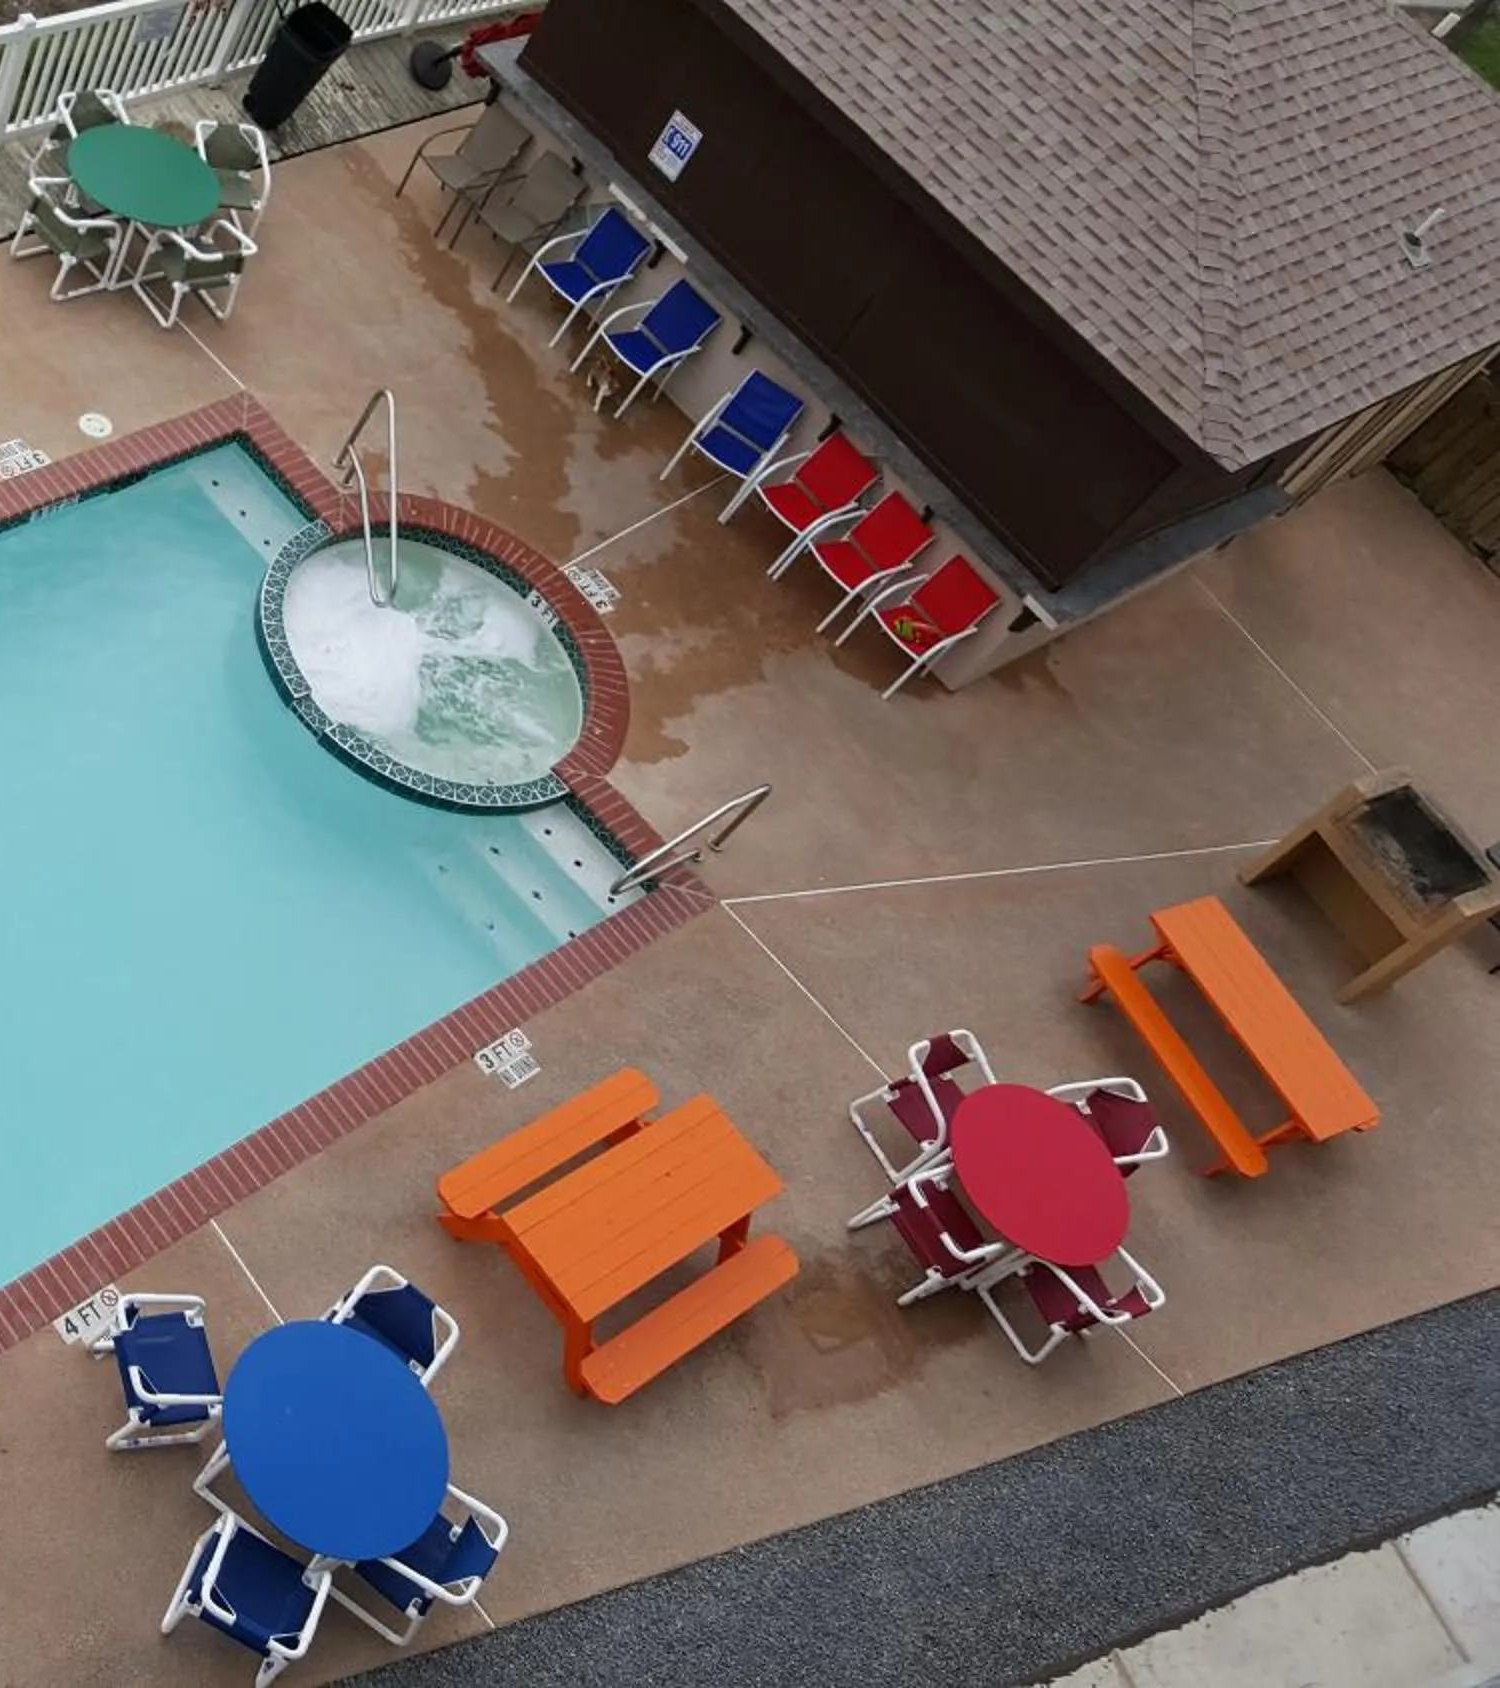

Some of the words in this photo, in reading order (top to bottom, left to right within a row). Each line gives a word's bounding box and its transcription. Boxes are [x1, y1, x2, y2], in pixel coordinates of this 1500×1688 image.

[32, 453, 45, 465] 3
[480, 1054, 495, 1069] 3
[492, 1042, 513, 1061] FT
[65, 1316, 79, 1335] 4
[77, 1300, 101, 1327] FT
